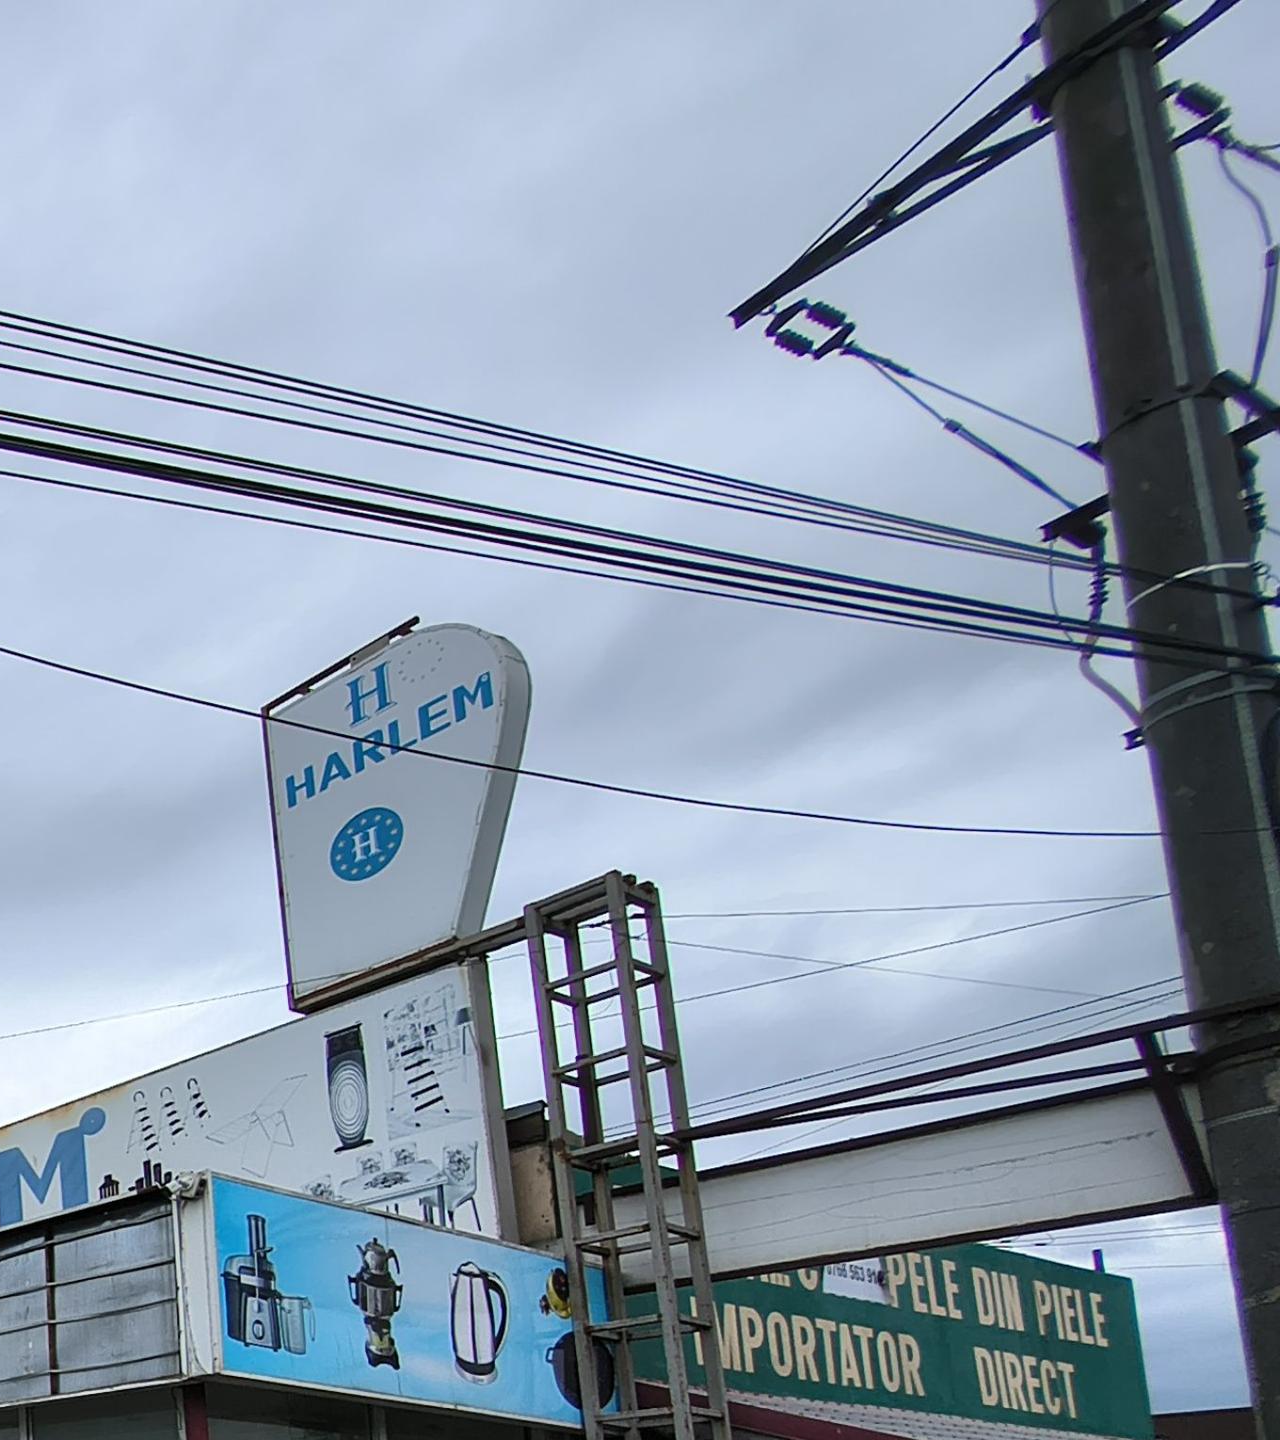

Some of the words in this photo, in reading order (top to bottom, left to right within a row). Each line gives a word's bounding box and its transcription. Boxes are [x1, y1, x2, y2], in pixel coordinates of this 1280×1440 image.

[344, 659, 398, 727] H
[285, 671, 496, 809] HARLEM
[350, 825, 382, 864] H
[971, 1266, 1025, 1333] DIN
[1033, 1280, 1110, 1348] PIELE
[972, 1346, 1078, 1419] DIRECT
